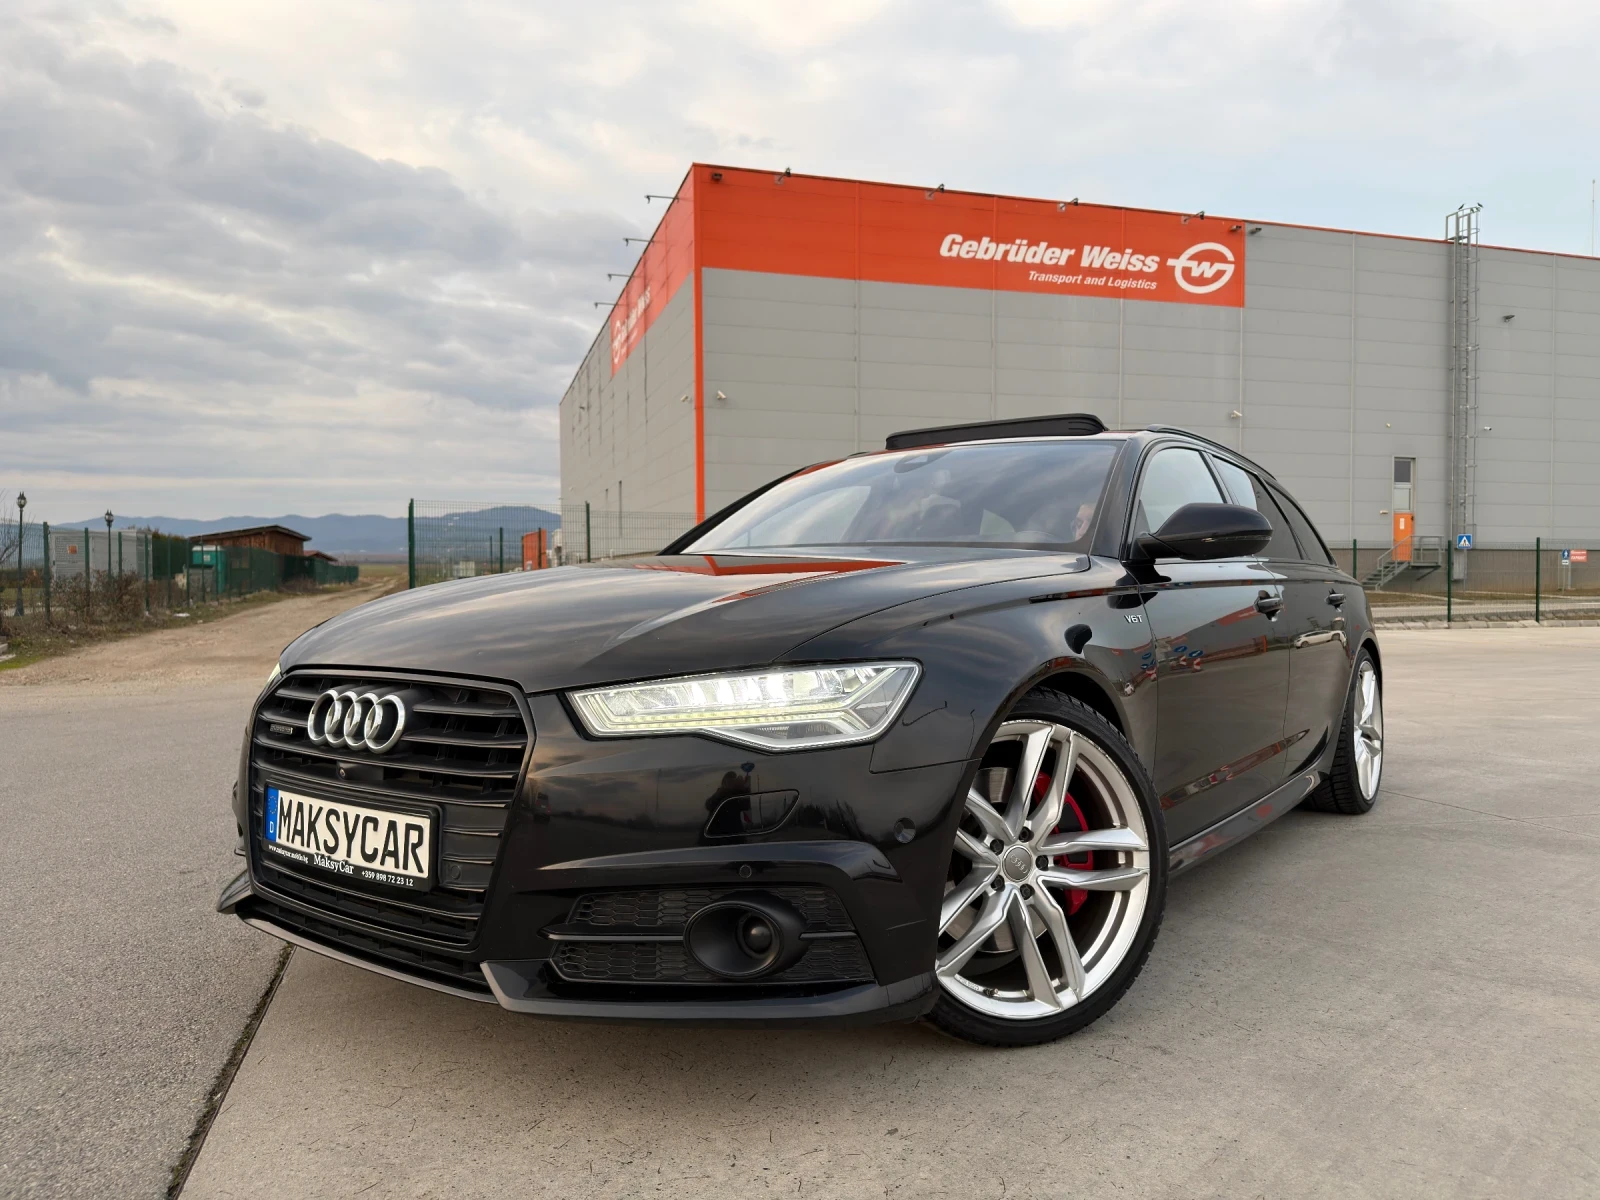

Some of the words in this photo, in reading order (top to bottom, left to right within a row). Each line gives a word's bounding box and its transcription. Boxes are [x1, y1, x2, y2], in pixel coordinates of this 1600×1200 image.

[940, 233, 1076, 266] Gebrüder
[1080, 245, 1160, 273] Weiss
[1028, 270, 1083, 285] Transport
[1083, 276, 1106, 286] and
[1107, 277, 1158, 290] Logistics
[1124, 614, 1143, 624] V6T
[269, 820, 275, 834] D
[278, 796, 425, 874] MAKSYCAR
[313, 853, 355, 875] MaksyCar
[361, 870, 375, 880] +359
[375, 872, 387, 882] 898
[387, 874, 396, 884] 72
[396, 876, 405, 885] 23
[405, 878, 414, 887] 12
